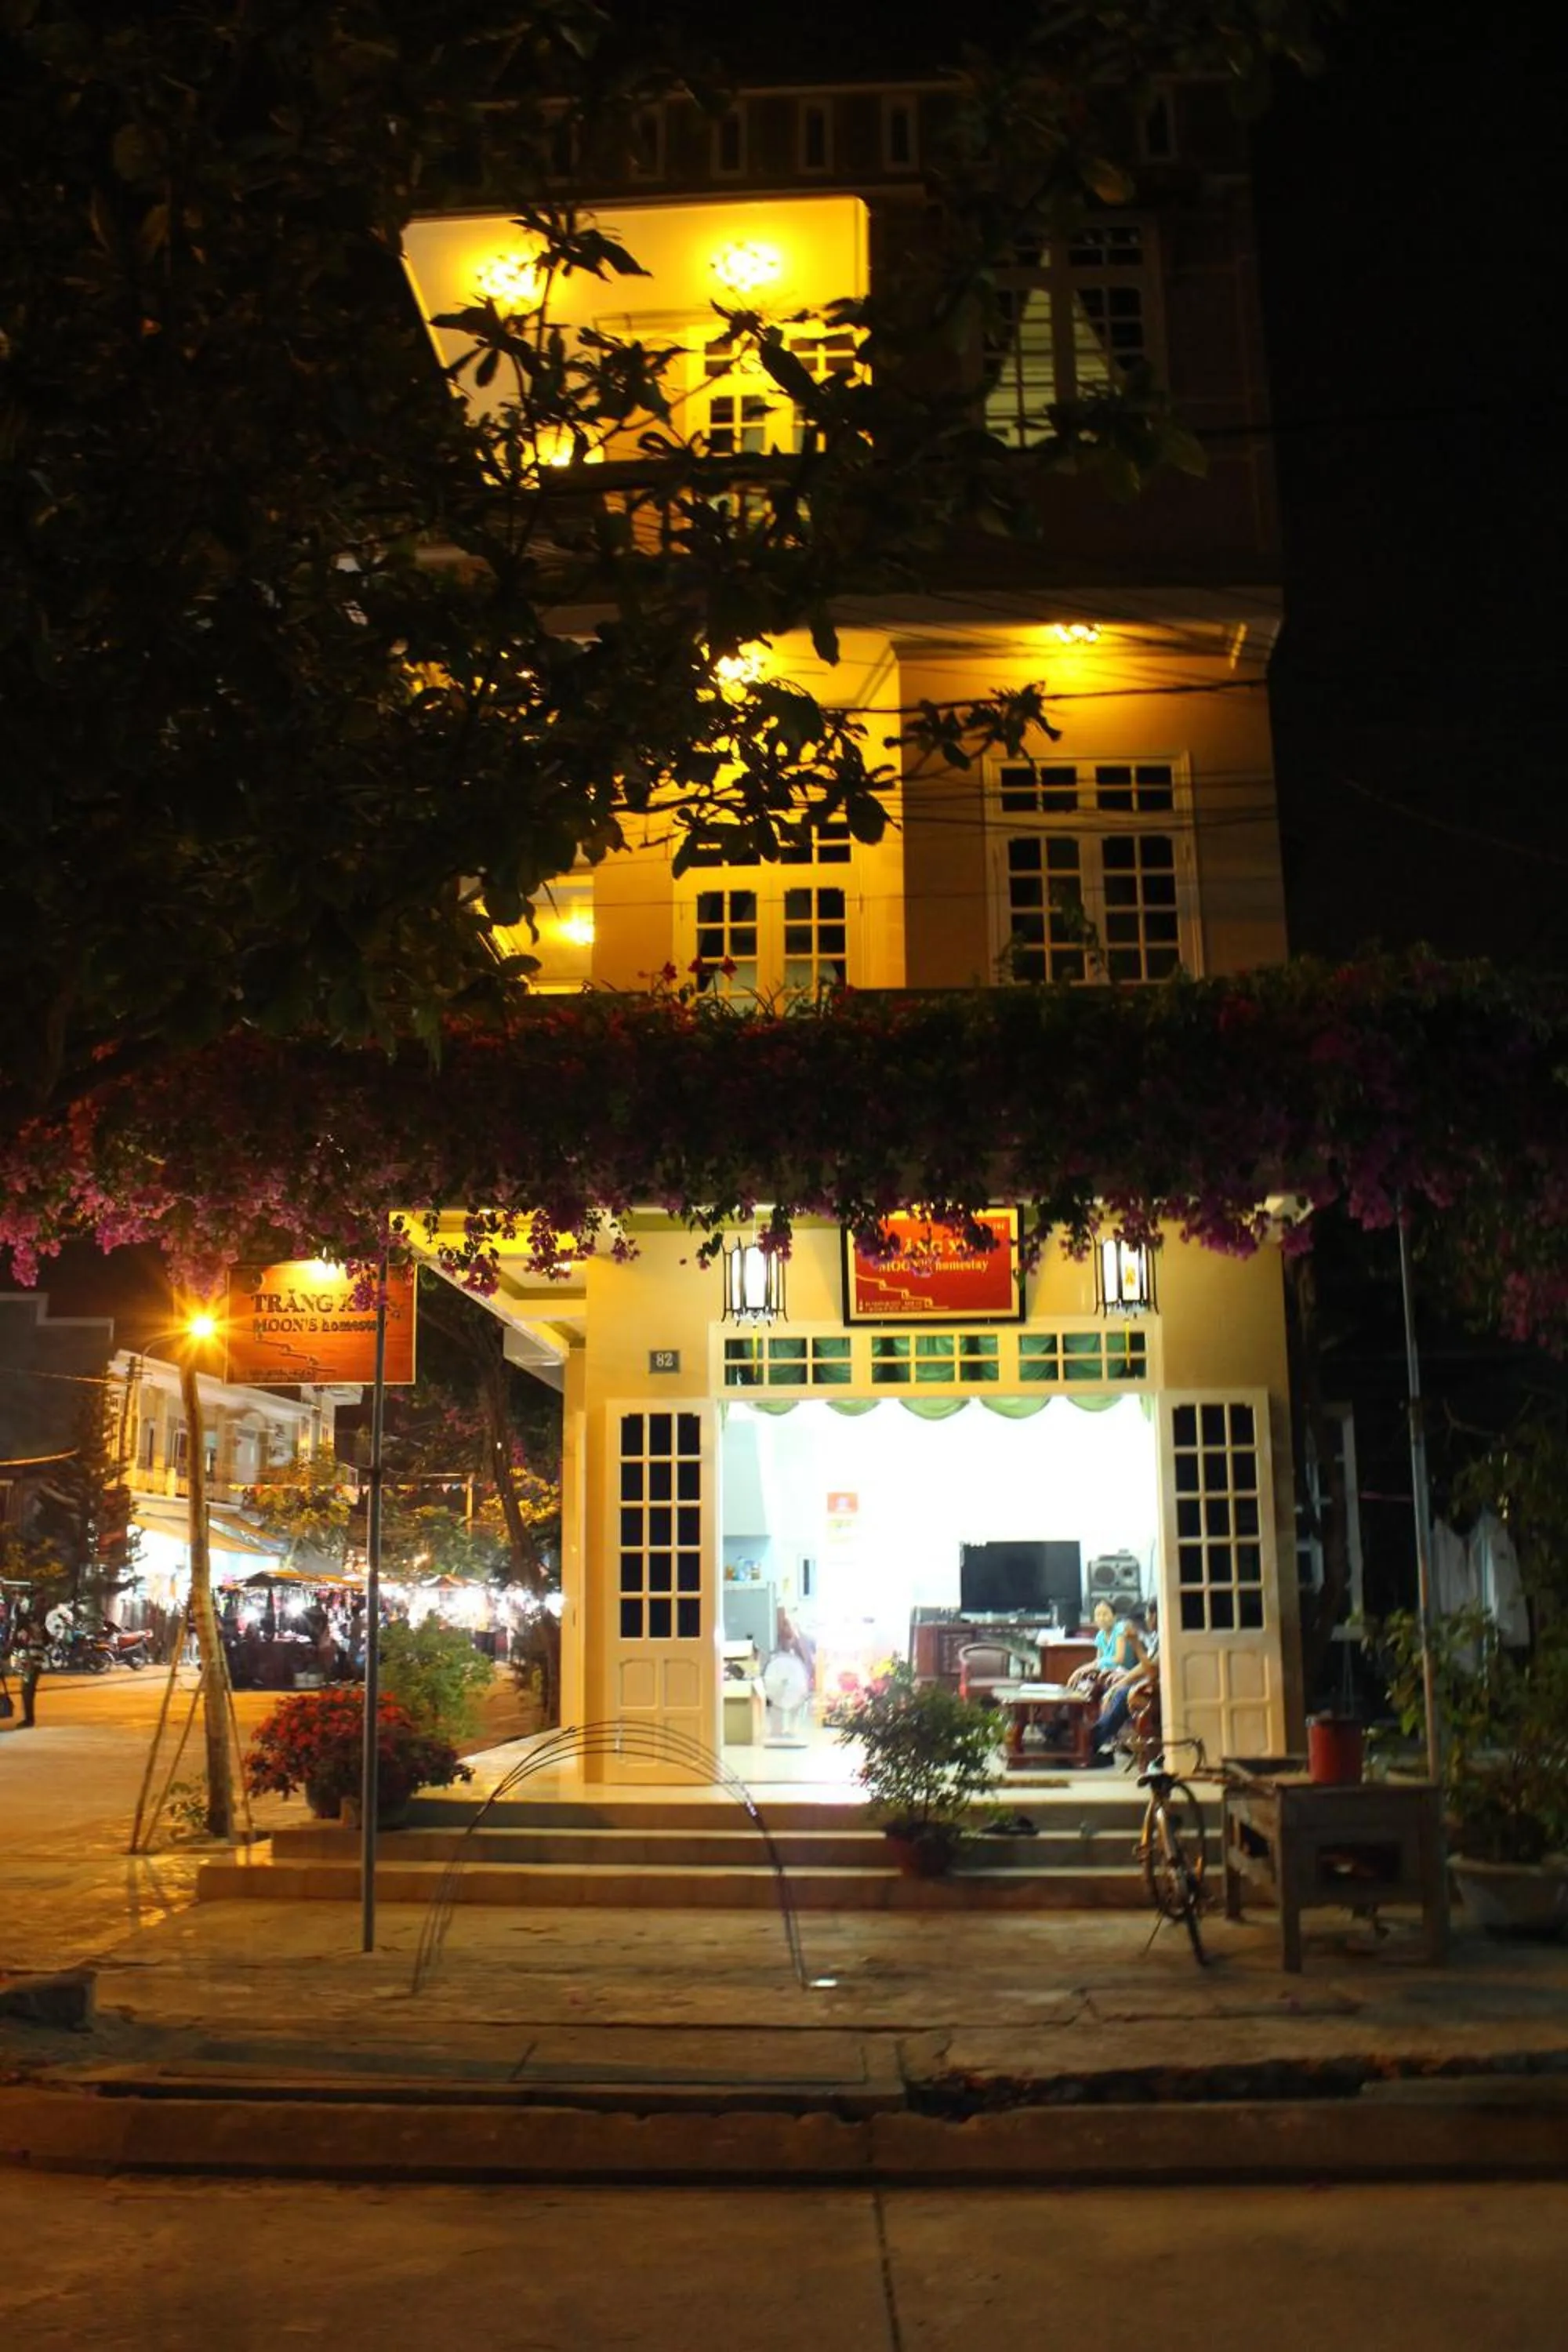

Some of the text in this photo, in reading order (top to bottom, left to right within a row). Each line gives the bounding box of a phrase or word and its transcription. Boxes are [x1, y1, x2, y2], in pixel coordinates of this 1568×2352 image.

[251, 1288, 333, 1313] TRĂNG
[252, 1318, 318, 1332] MOON'S
[656, 1352, 673, 1367] 82
